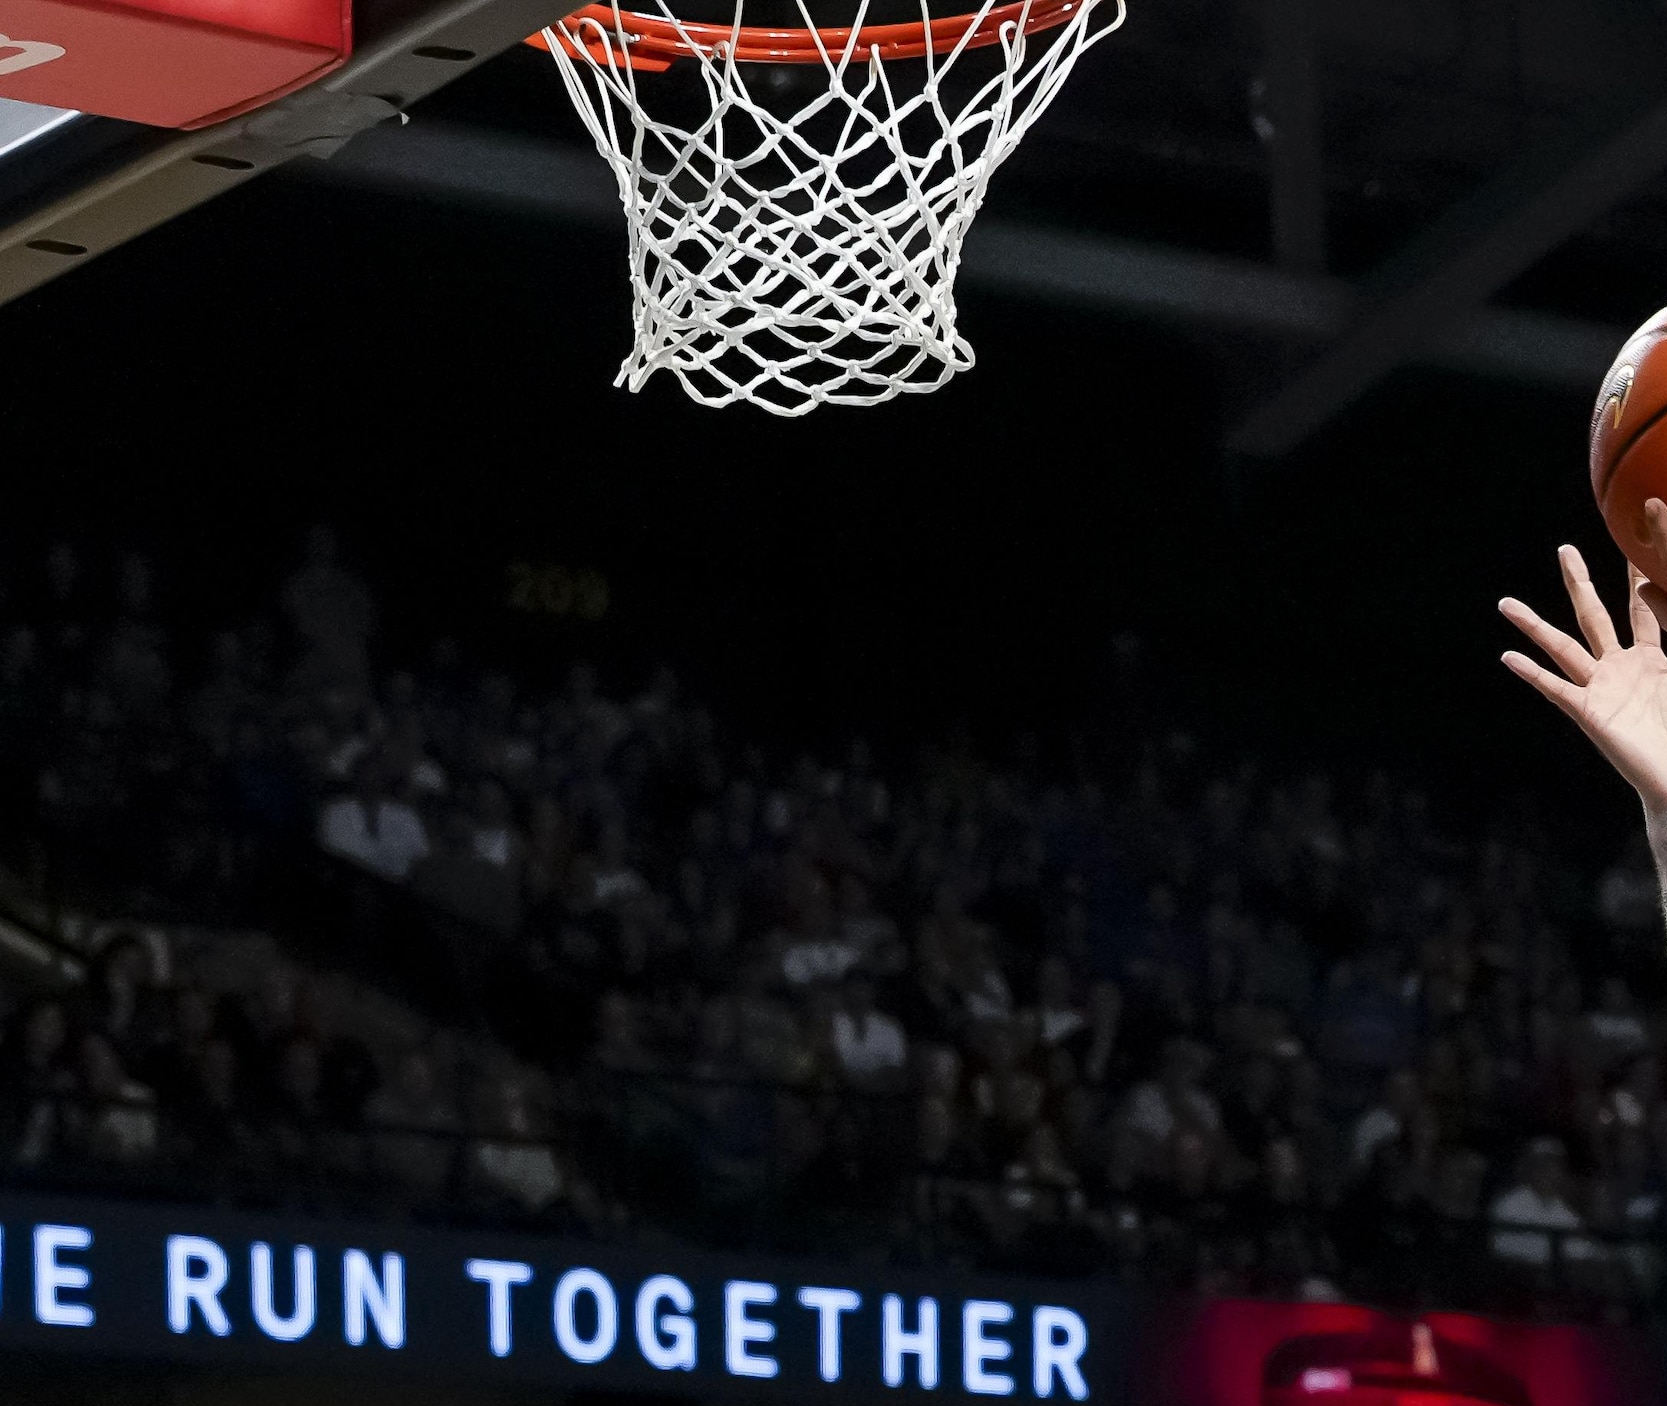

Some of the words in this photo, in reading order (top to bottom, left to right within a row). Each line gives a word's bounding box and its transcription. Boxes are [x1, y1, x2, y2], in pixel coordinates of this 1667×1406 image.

[0, 1224, 95, 1327] E
[167, 1235, 407, 1348] RUN
[467, 1259, 1090, 1401] TOGETHER
